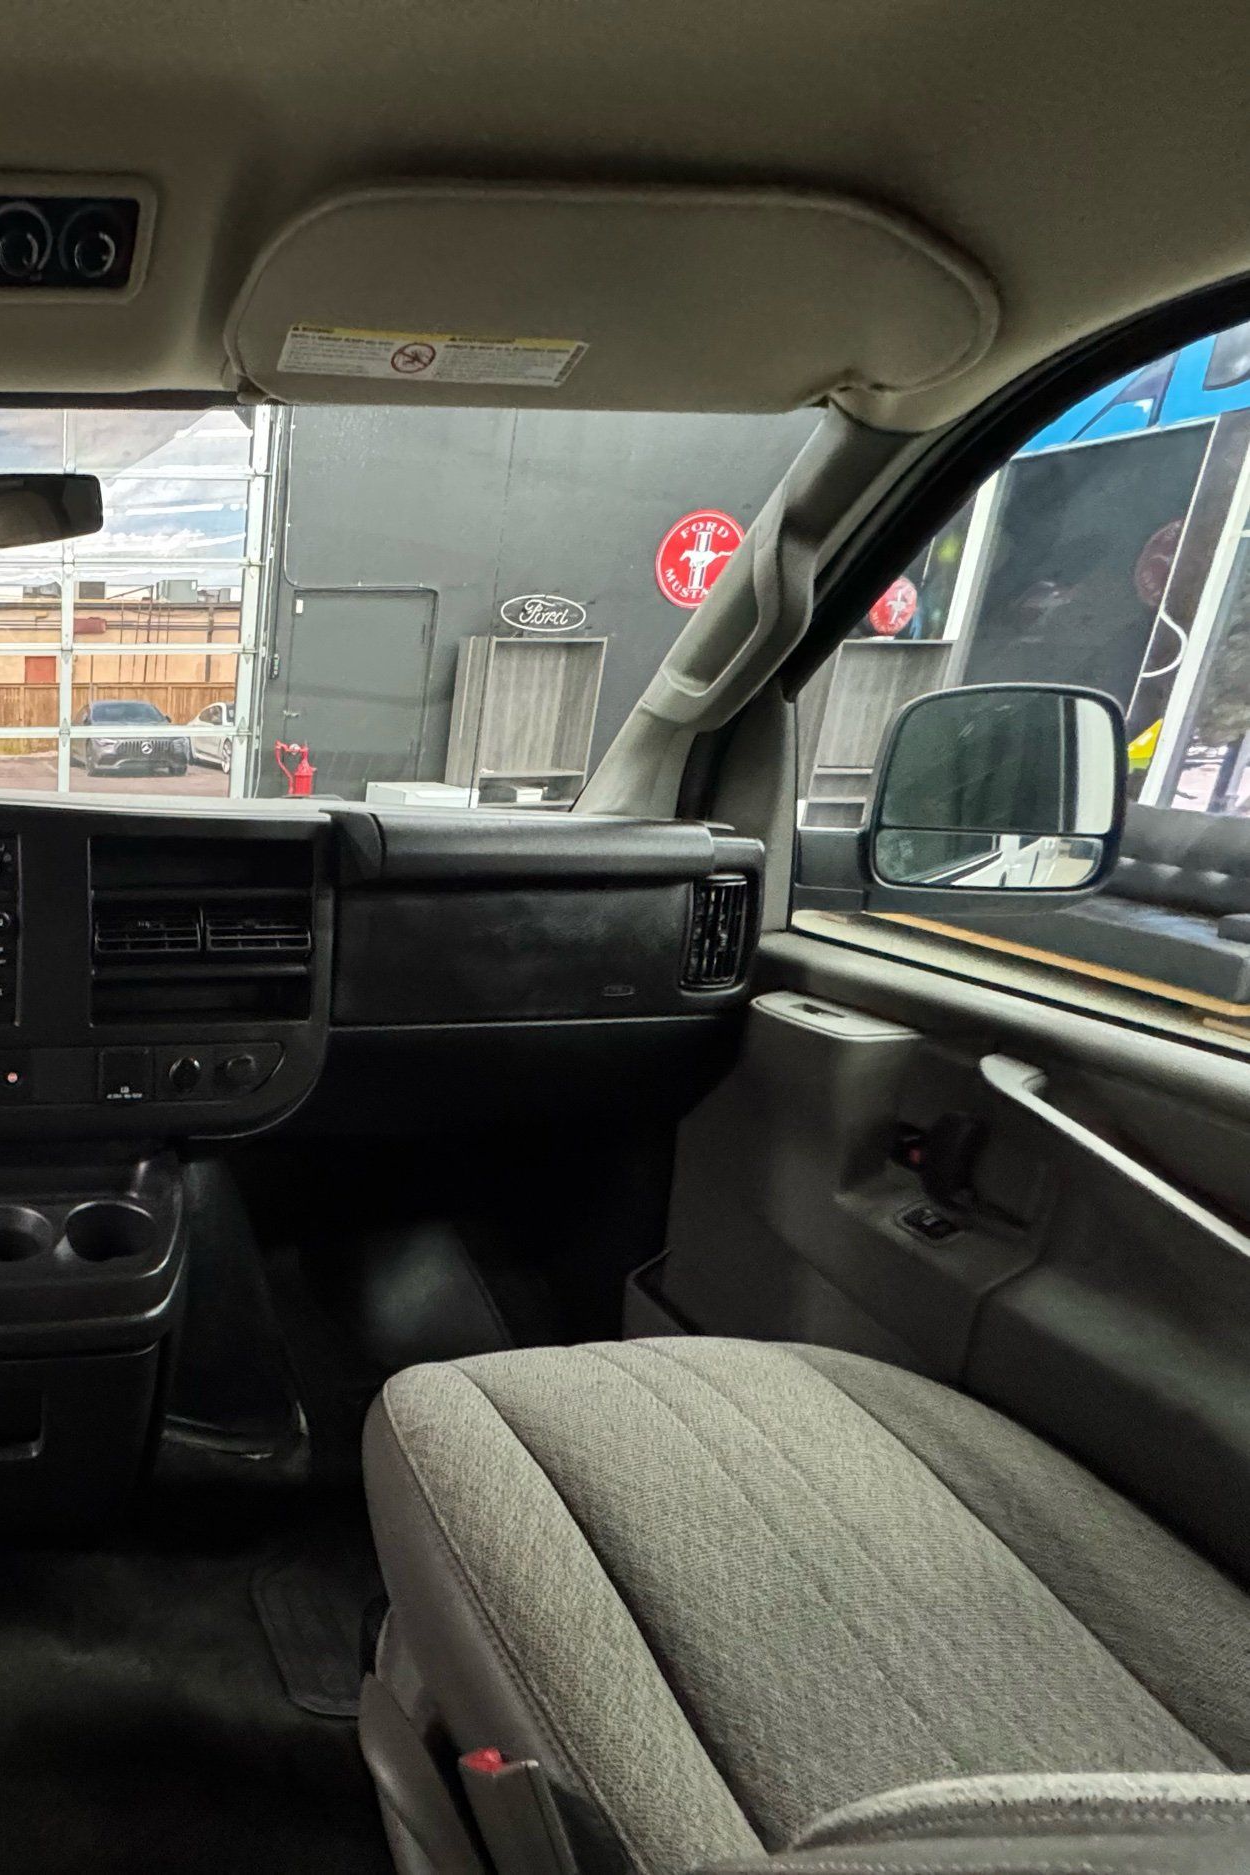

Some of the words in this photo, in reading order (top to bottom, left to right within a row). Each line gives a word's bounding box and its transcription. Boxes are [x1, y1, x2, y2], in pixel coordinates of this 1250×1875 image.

[680, 521, 730, 539] FORD
[664, 567, 711, 599] MUSTA
[519, 598, 569, 625] Ford
